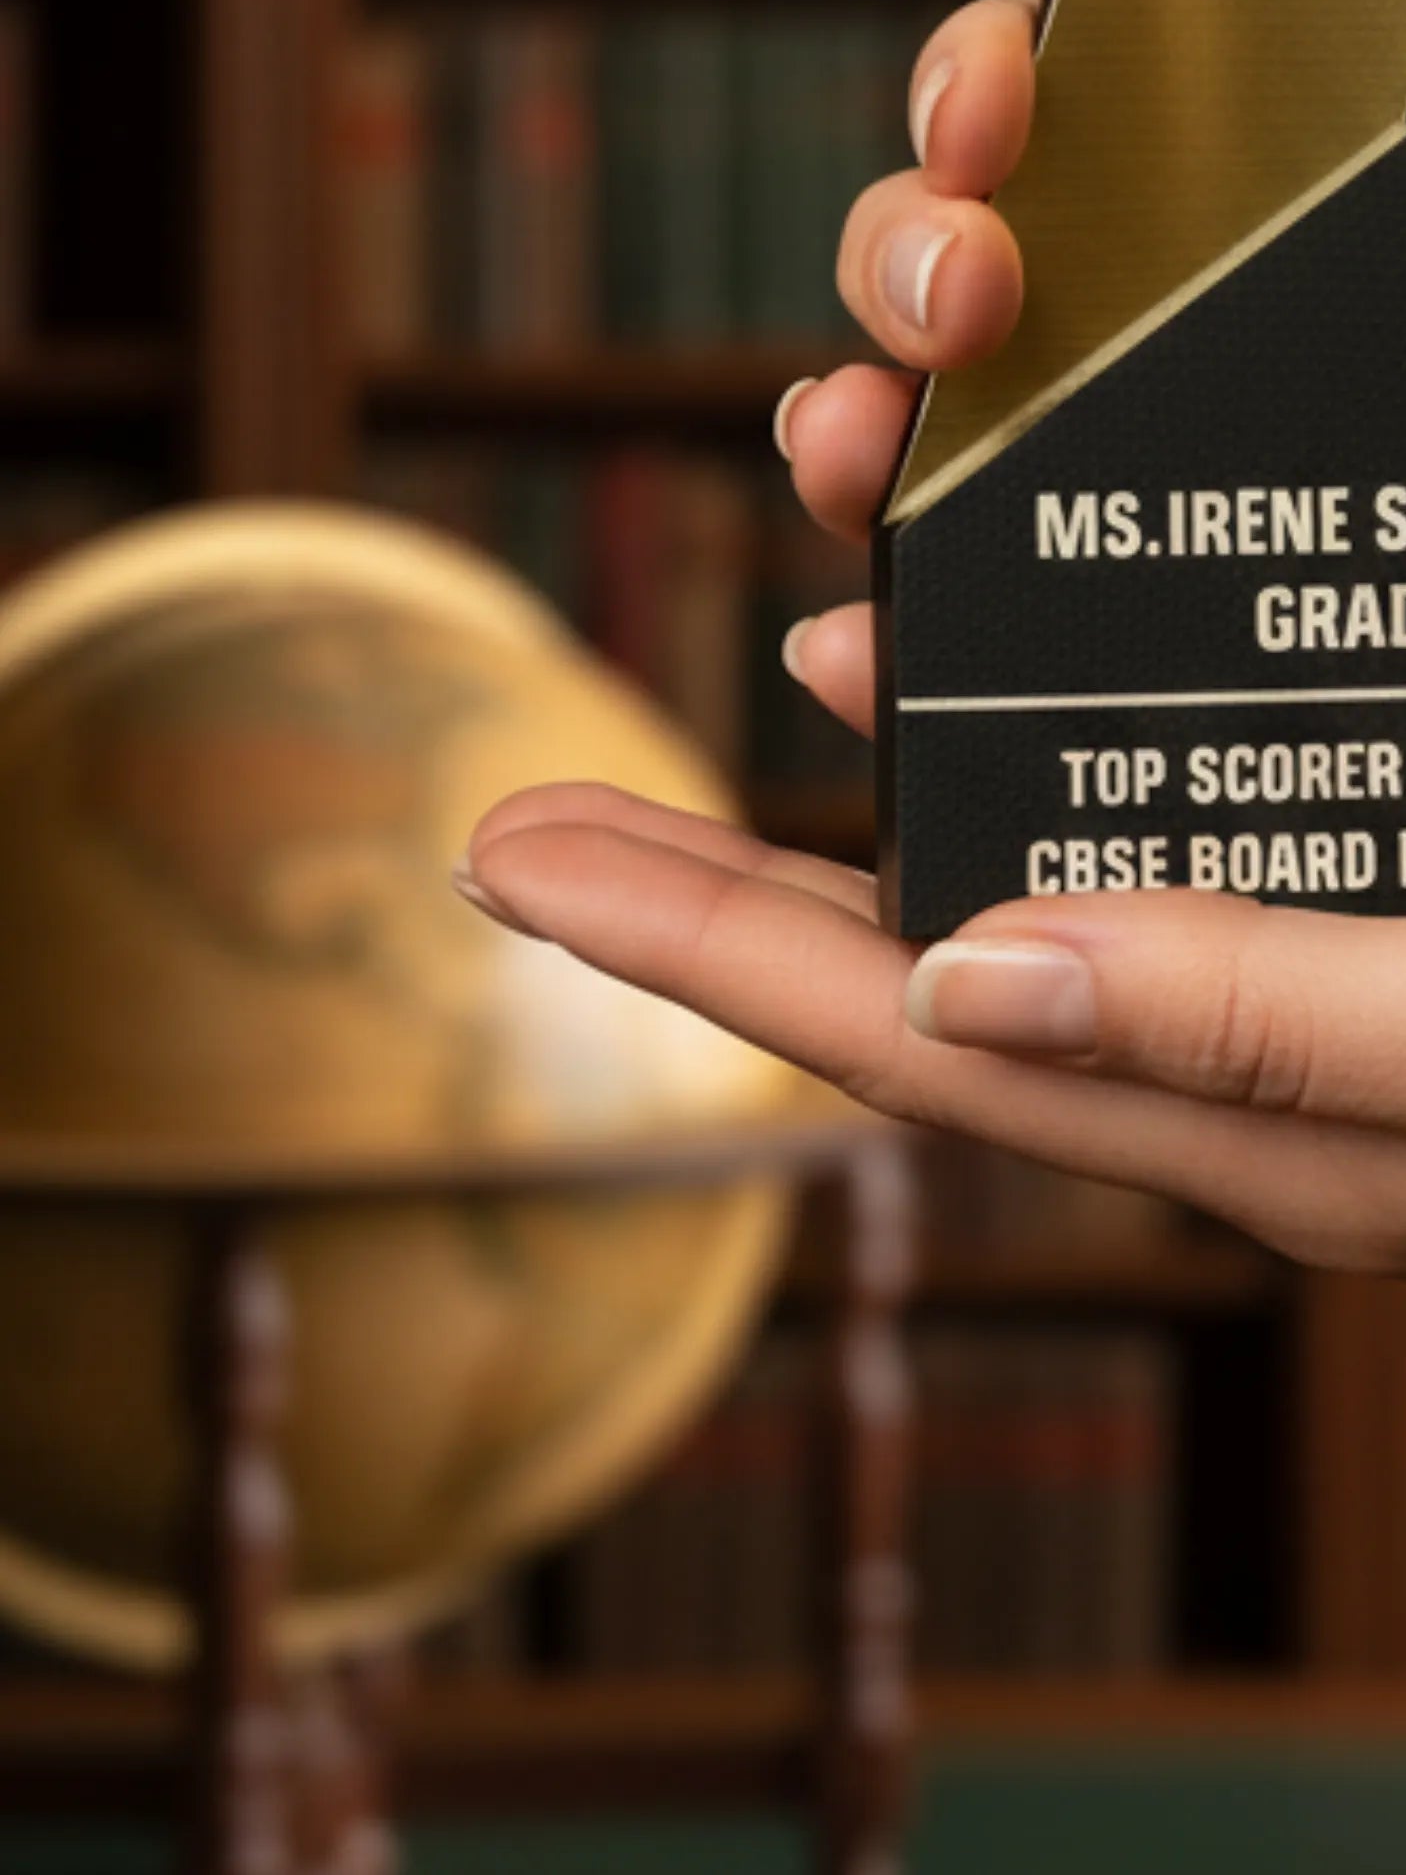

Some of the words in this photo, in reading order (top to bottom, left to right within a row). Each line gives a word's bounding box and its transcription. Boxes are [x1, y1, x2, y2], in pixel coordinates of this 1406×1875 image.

[1037, 487, 1353, 559] MS.IRENE
[1060, 748, 1167, 807] TOP
[1188, 742, 1402, 804] SCORER
[1027, 836, 1169, 896] CBSE
[1190, 831, 1378, 893] BOARD
